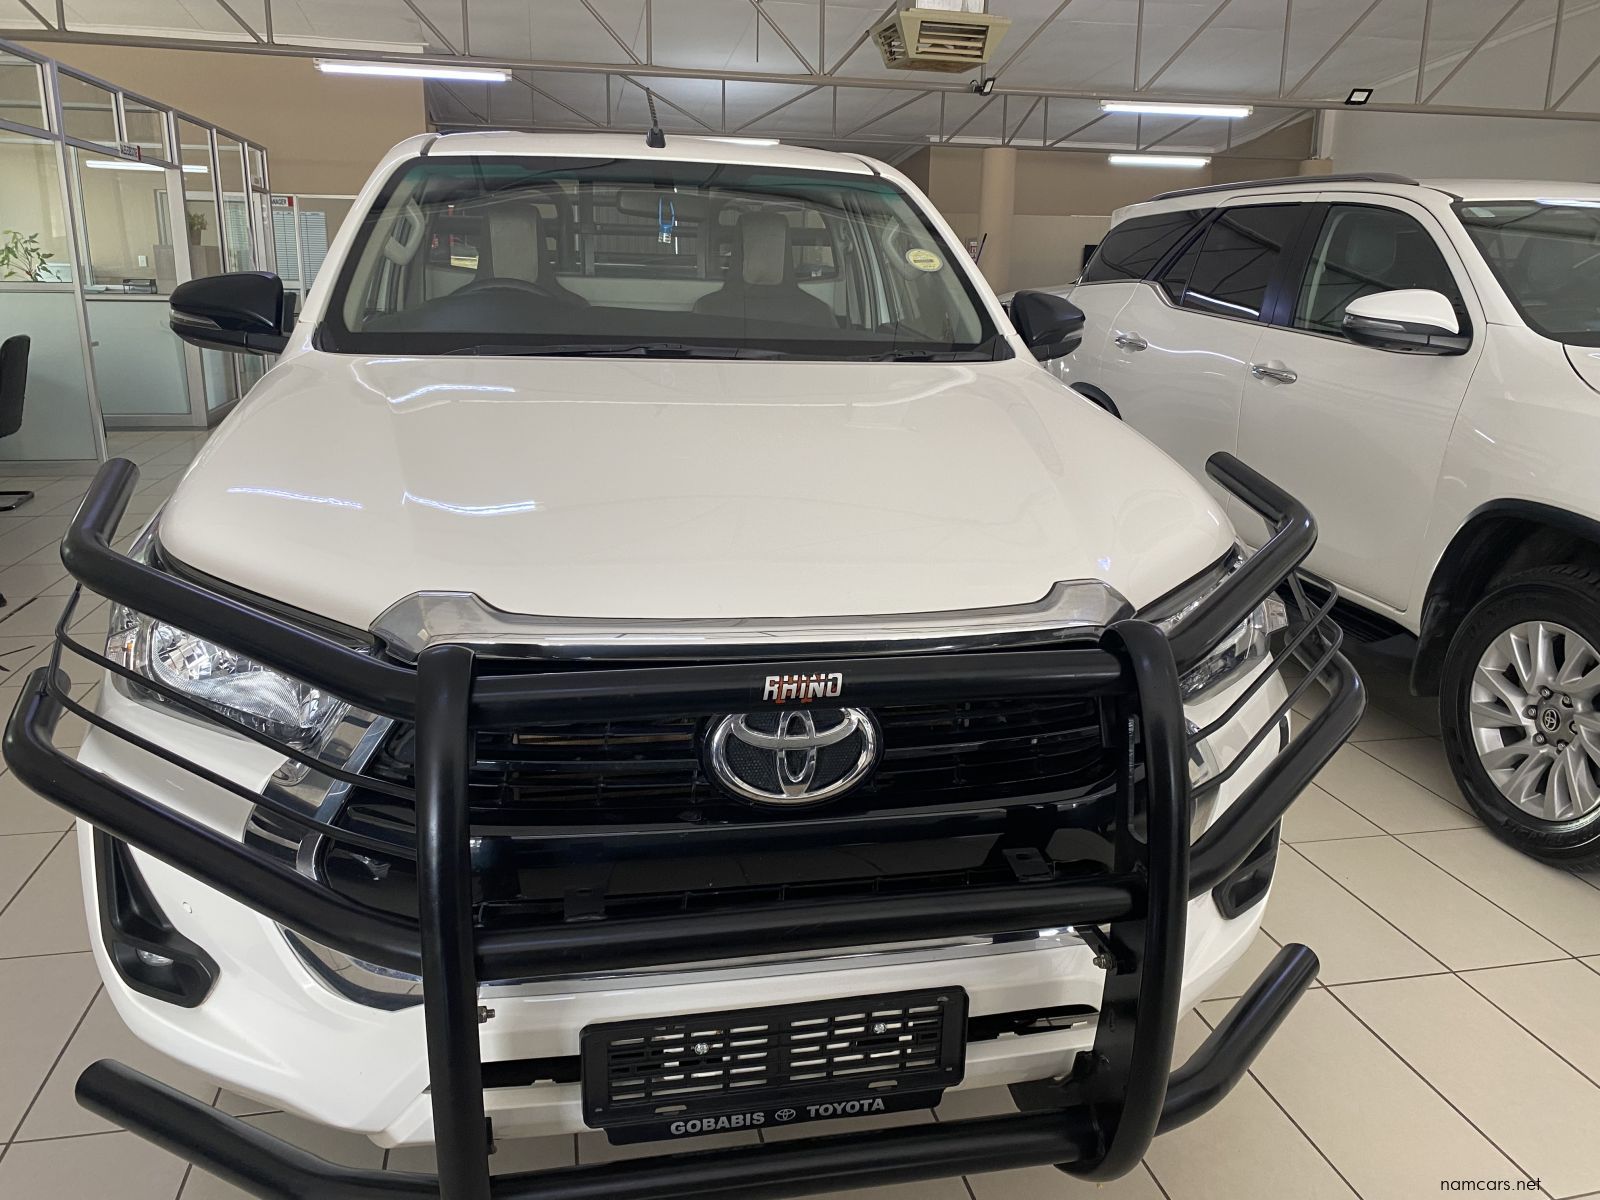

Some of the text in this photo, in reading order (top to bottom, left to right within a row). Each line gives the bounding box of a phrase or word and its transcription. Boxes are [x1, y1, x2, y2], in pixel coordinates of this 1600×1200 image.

[763, 673, 842, 701] RHINO
[670, 1098, 885, 1135] GOBABIS TOYOTA
